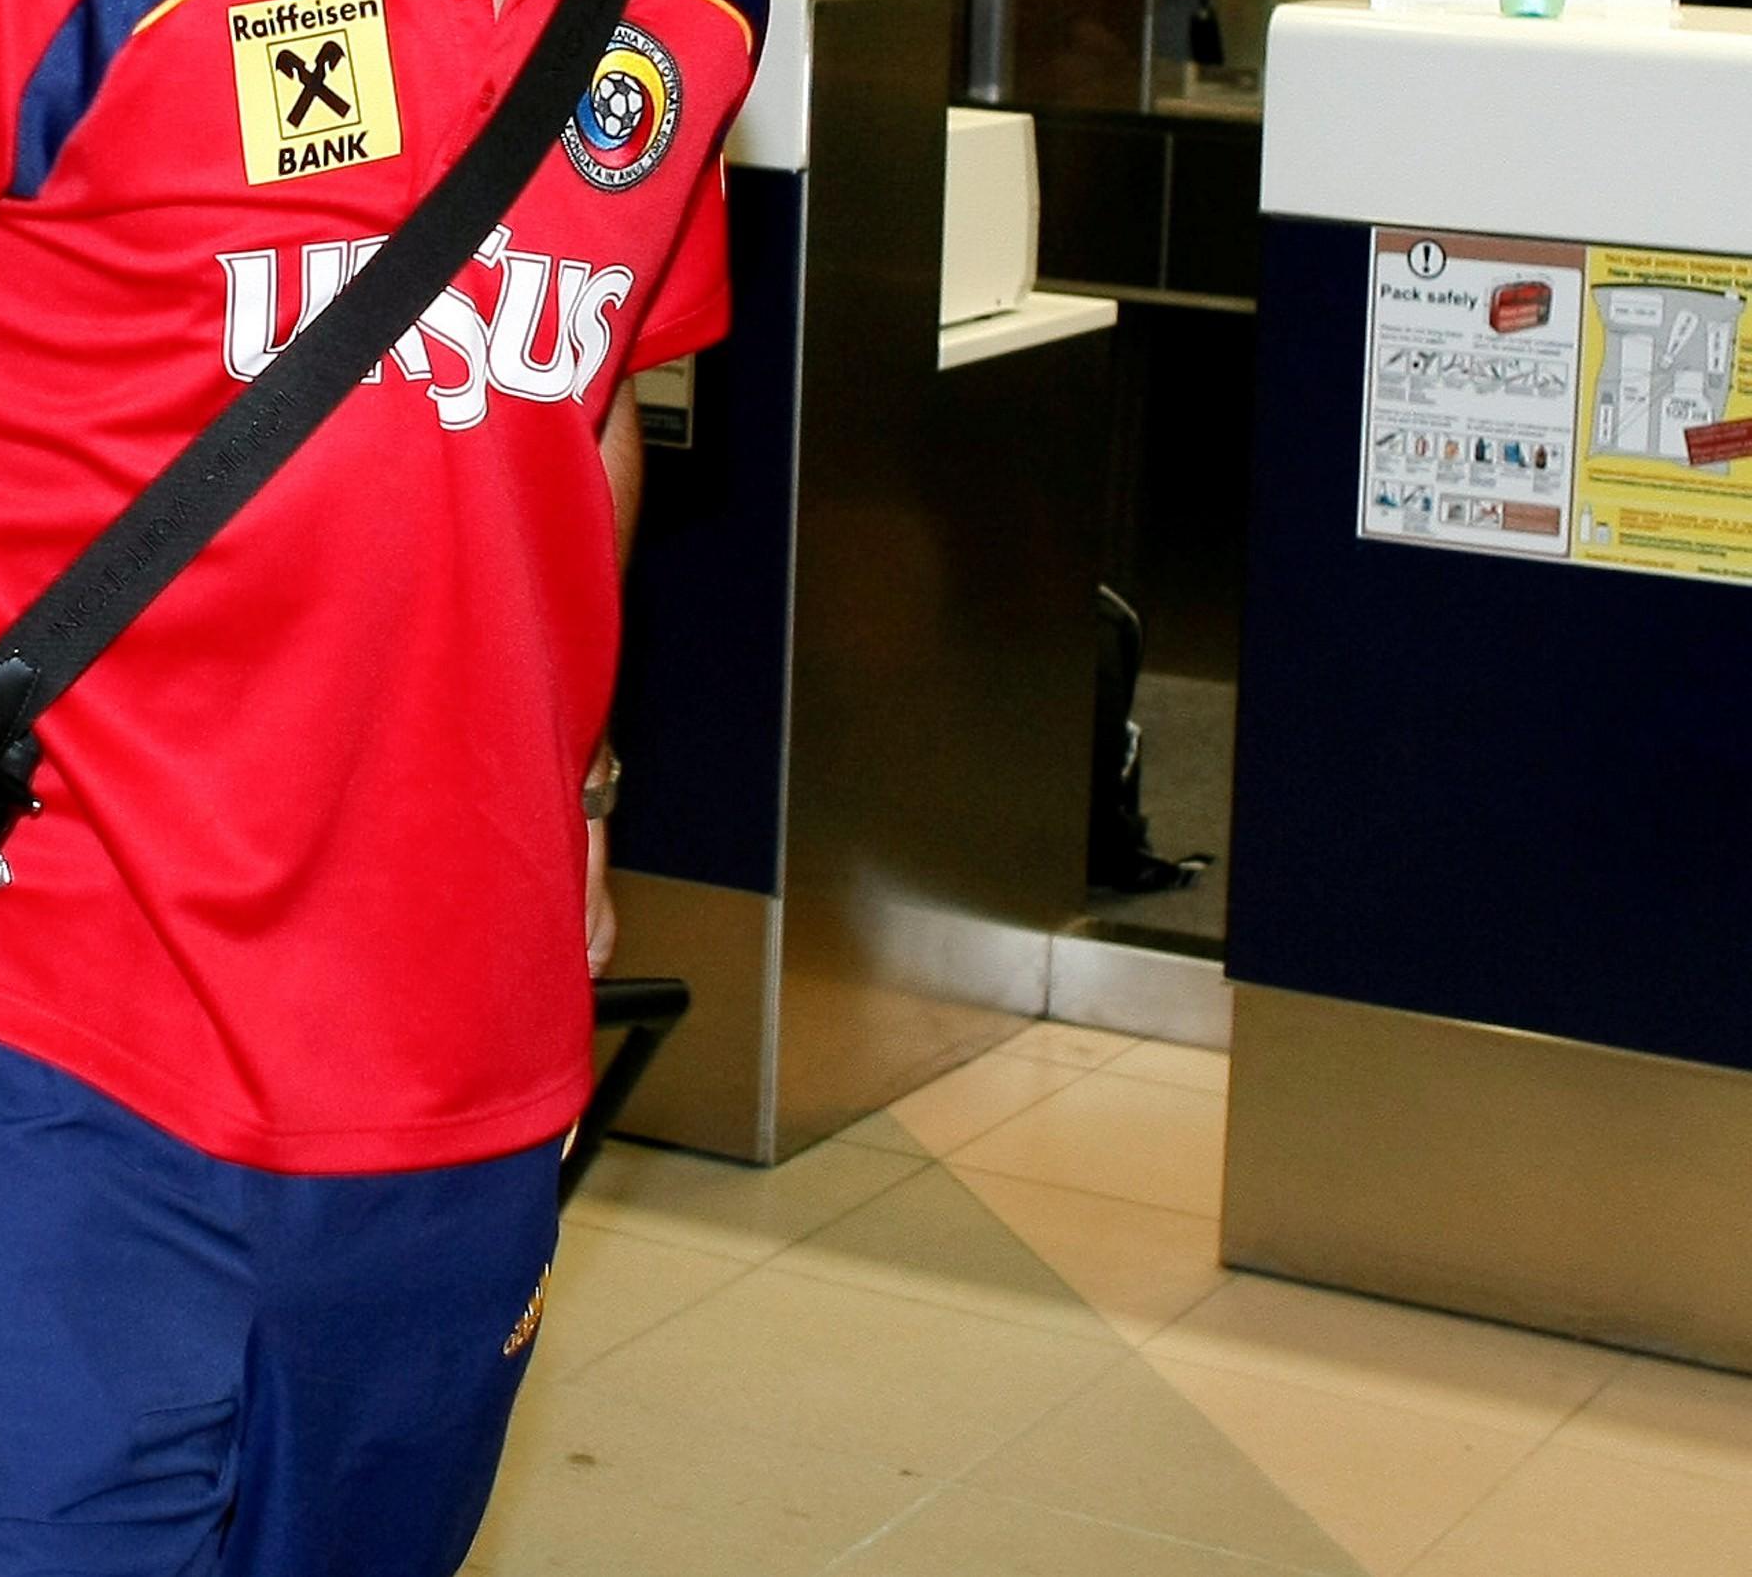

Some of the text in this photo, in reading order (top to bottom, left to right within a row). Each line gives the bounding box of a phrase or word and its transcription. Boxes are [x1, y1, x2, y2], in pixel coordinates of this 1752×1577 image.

[276, 129, 370, 177] BANK
[1380, 283, 1479, 312] Pack safely
